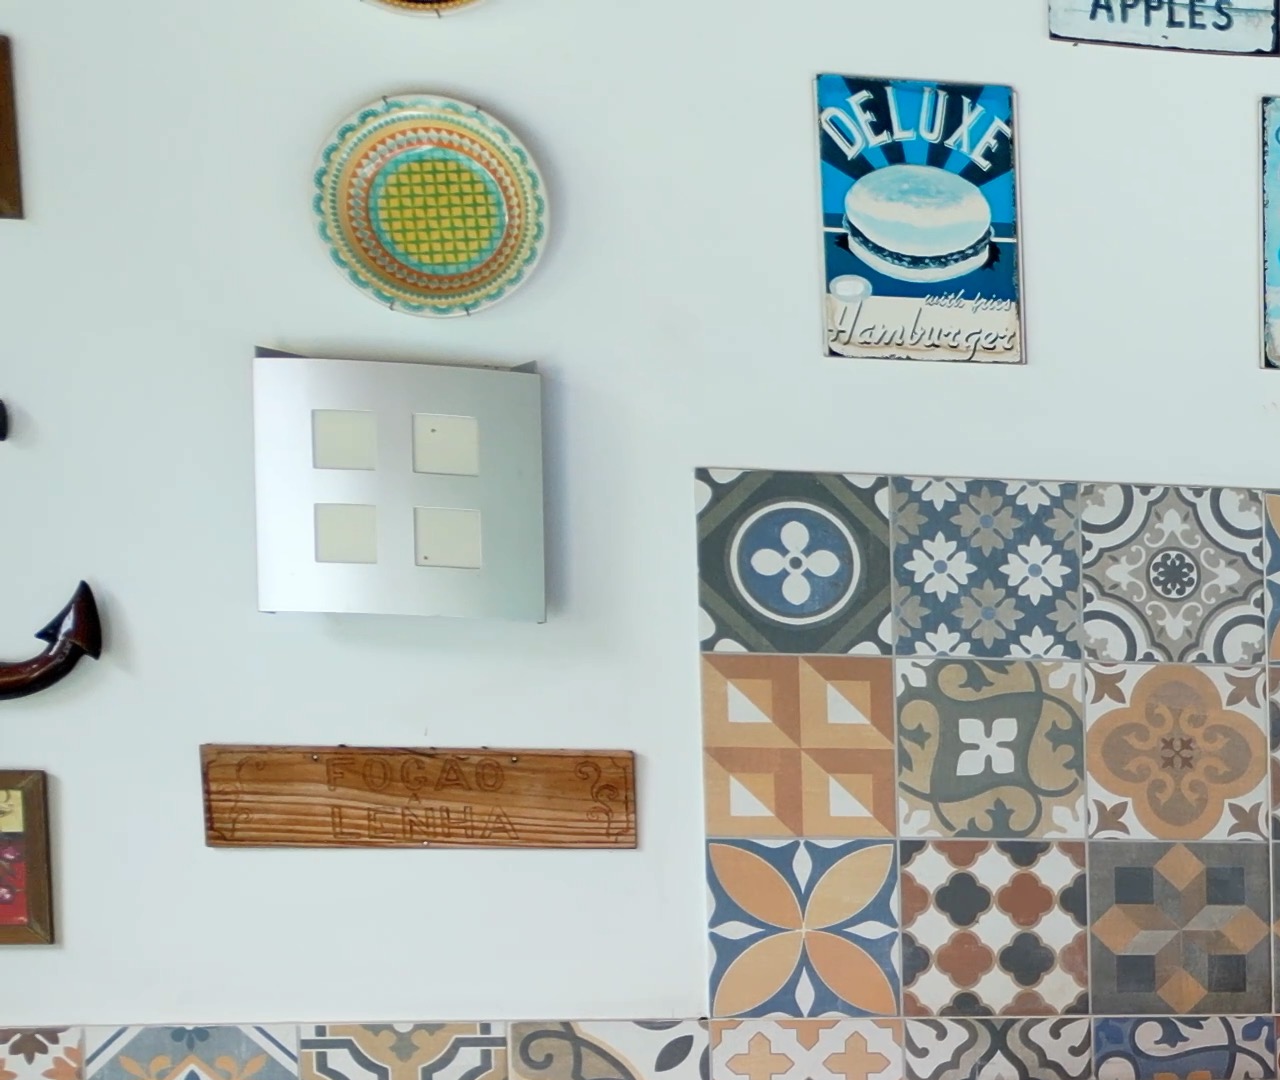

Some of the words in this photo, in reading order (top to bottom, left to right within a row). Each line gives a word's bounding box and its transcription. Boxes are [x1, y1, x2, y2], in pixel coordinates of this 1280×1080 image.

[1089, 0, 1234, 31] APPLES
[819, 86, 1013, 172] DELUXE
[925, 289, 965, 308] with
[827, 300, 1016, 361] Hamburger
[331, 805, 520, 840] LENHA
